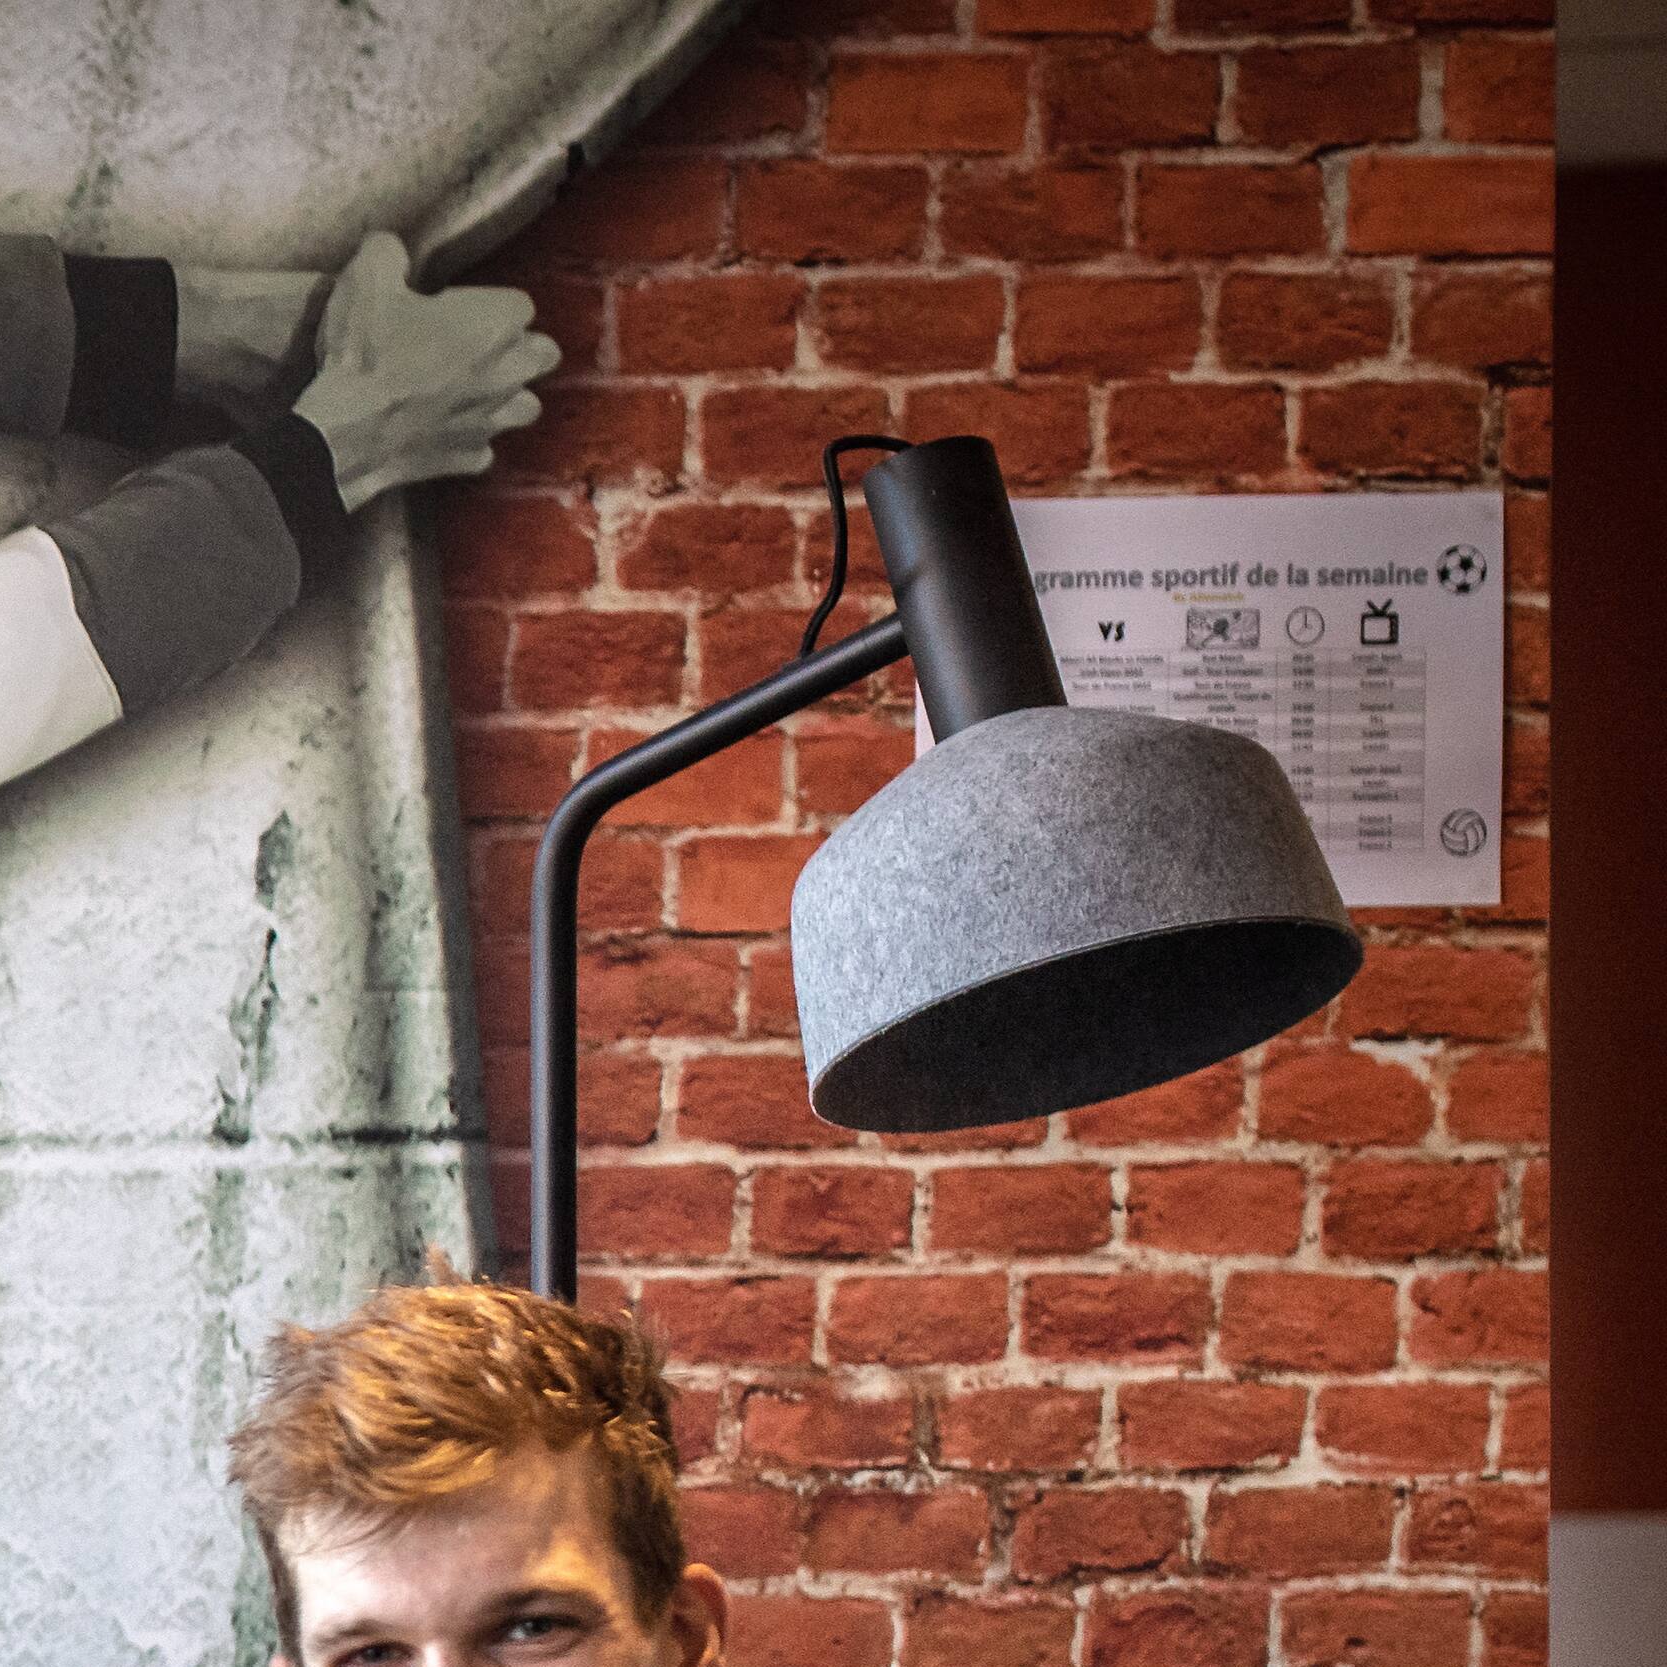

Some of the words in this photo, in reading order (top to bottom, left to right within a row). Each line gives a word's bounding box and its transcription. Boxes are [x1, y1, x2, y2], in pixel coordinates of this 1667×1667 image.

[1034, 569, 1144, 595] gramme
[1151, 561, 1240, 592] sportif
[1246, 562, 1279, 587] de
[1287, 562, 1310, 587] la
[1317, 560, 1429, 587] semaine
